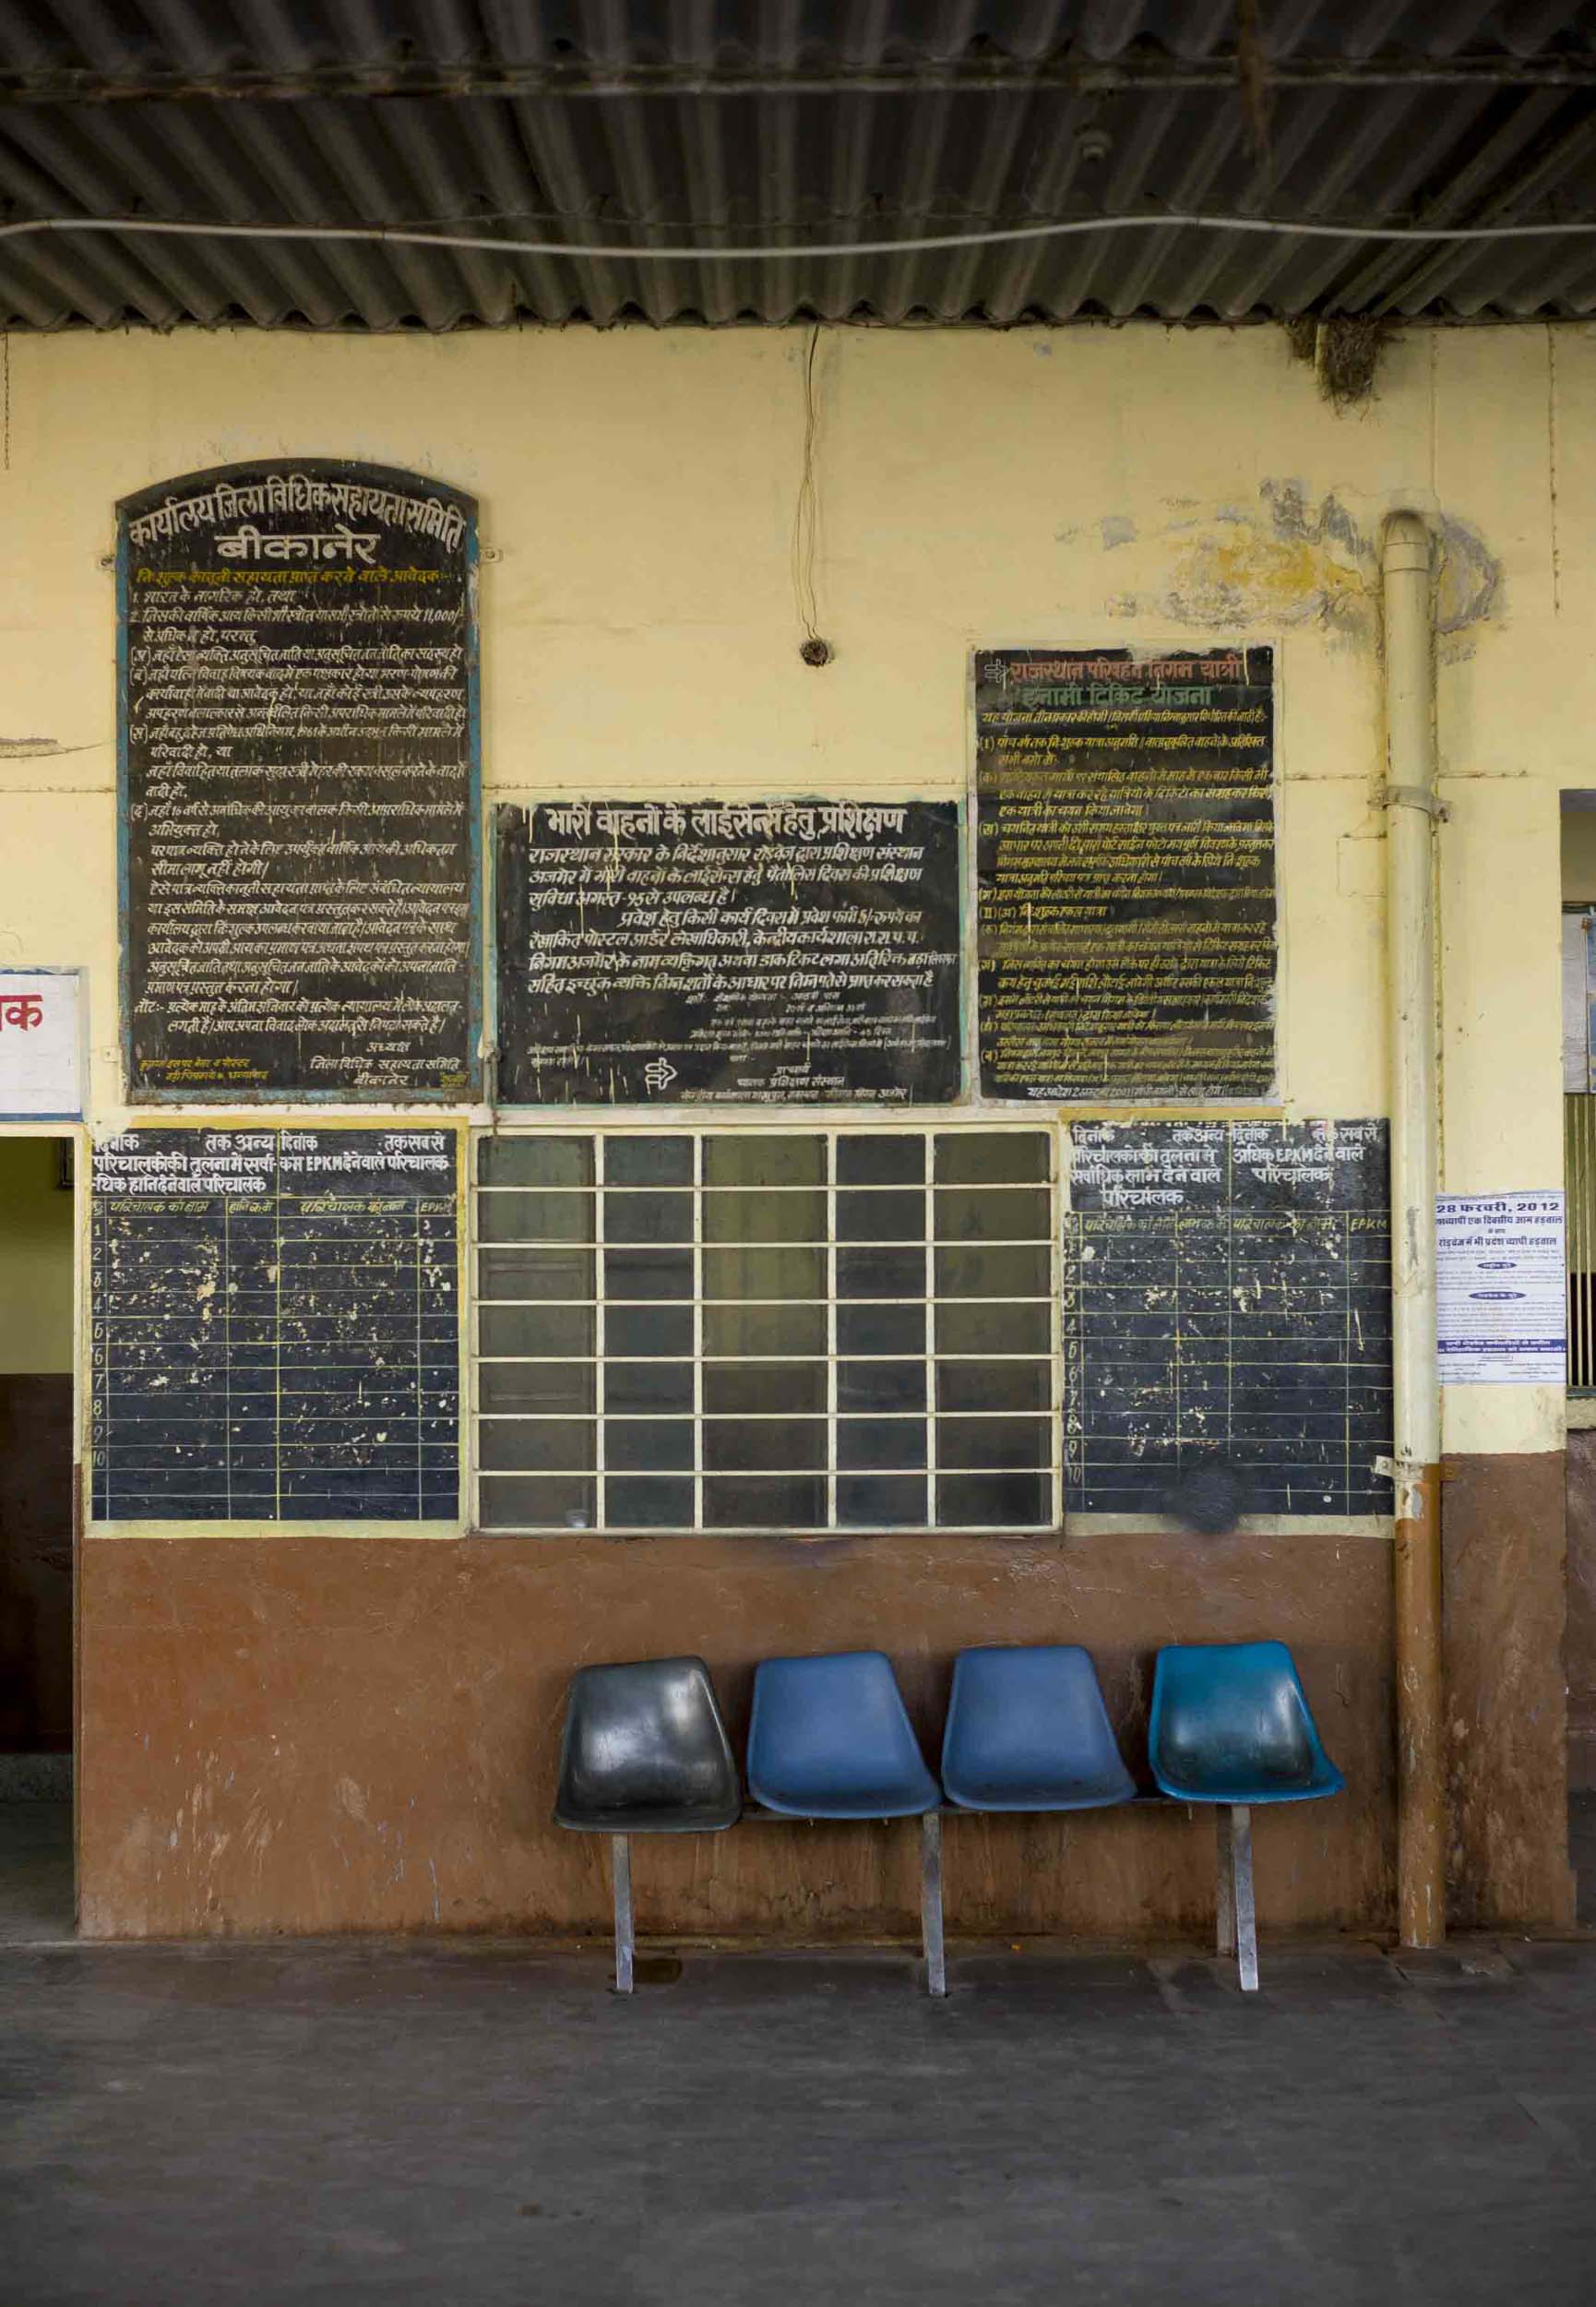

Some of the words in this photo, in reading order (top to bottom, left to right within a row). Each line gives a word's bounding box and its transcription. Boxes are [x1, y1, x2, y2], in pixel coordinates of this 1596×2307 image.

[215, 484, 264, 520] जिला
[214, 524, 381, 564] बीकानेर
[662, 802, 686, 834] के
[655, 844, 670, 862] के
[205, 1133, 232, 1153] तक
[235, 1134, 275, 1153] अन्य
[280, 1154, 304, 1171] कम
[306, 1155, 343, 1171] EPKM
[387, 1151, 449, 1173] परिचालक
[204, 1173, 267, 1194] परिचालक
[1436, 1204, 1457, 1213] 28
[1517, 1202, 1559, 1212] 2012
[93, 1247, 102, 1258] 2
[92, 1297, 103, 1313] 4
[92, 1349, 103, 1365] 6
[93, 1373, 104, 1388] 7
[92, 1399, 102, 1416] 8
[92, 1425, 103, 1443] 9
[91, 1450, 105, 1466] 10
